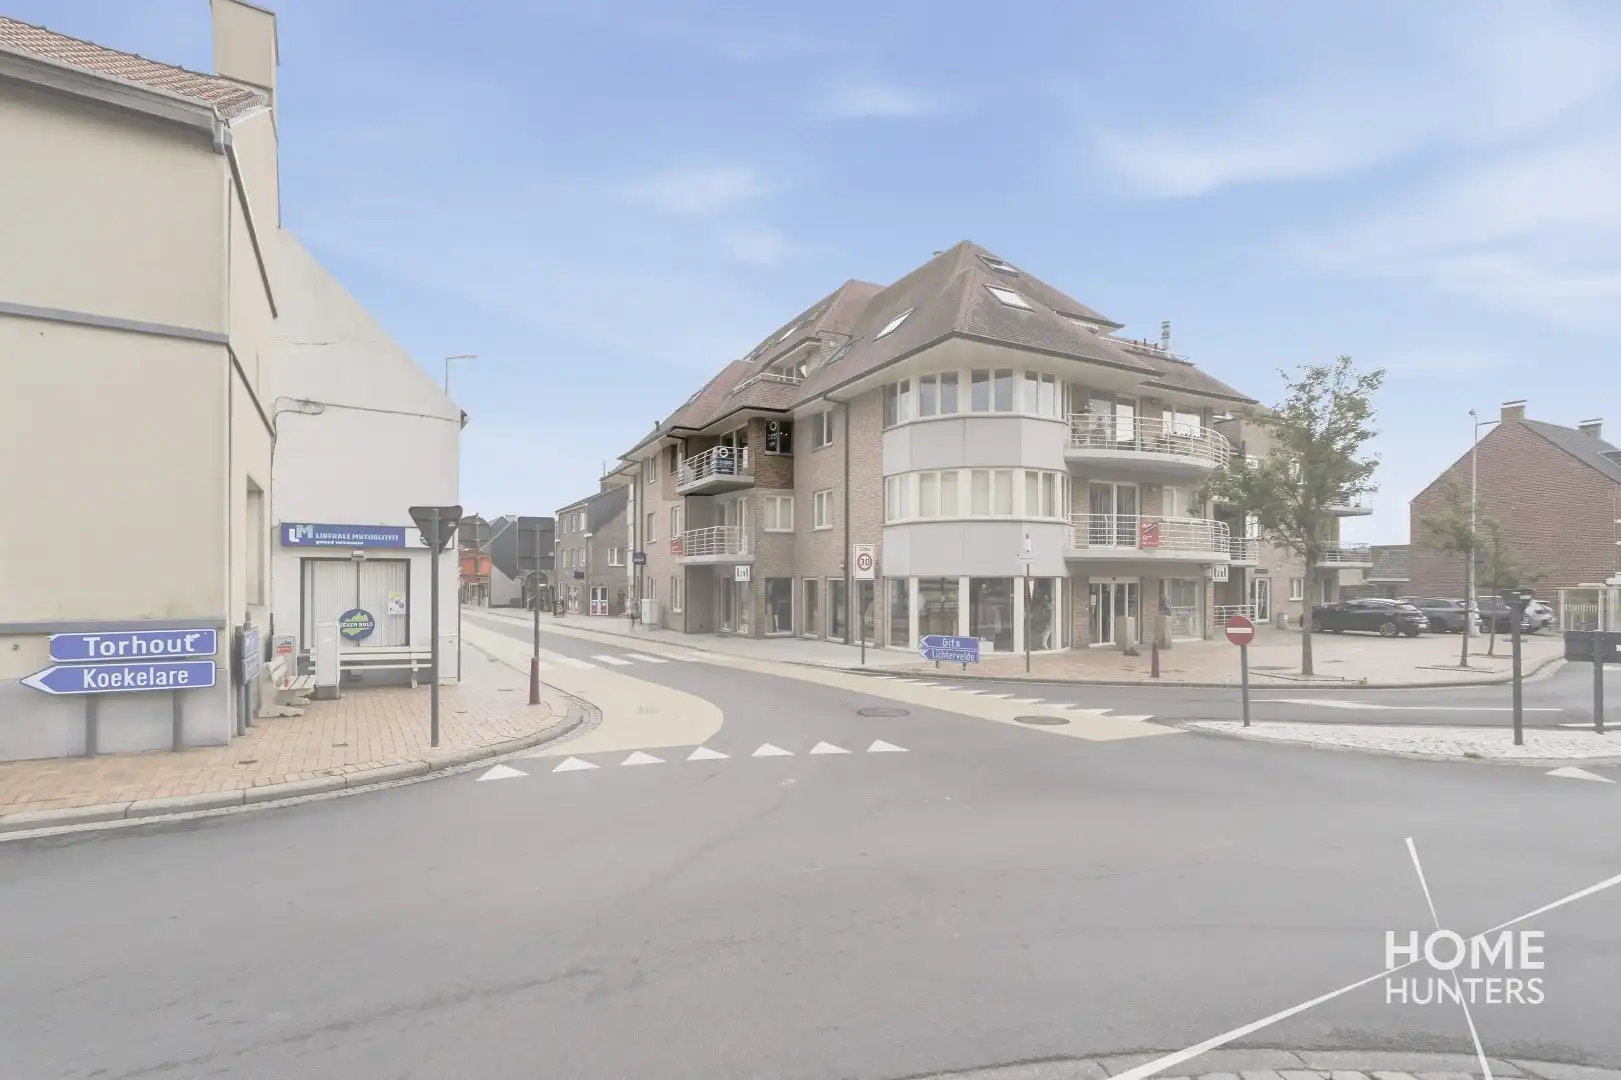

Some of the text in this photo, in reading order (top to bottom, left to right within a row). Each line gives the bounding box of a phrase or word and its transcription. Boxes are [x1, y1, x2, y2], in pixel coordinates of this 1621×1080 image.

[83, 635, 195, 656] Torhout
[942, 638, 960, 647] Gits
[932, 650, 975, 661] Lichtervelde
[83, 668, 189, 688] Koekelare
